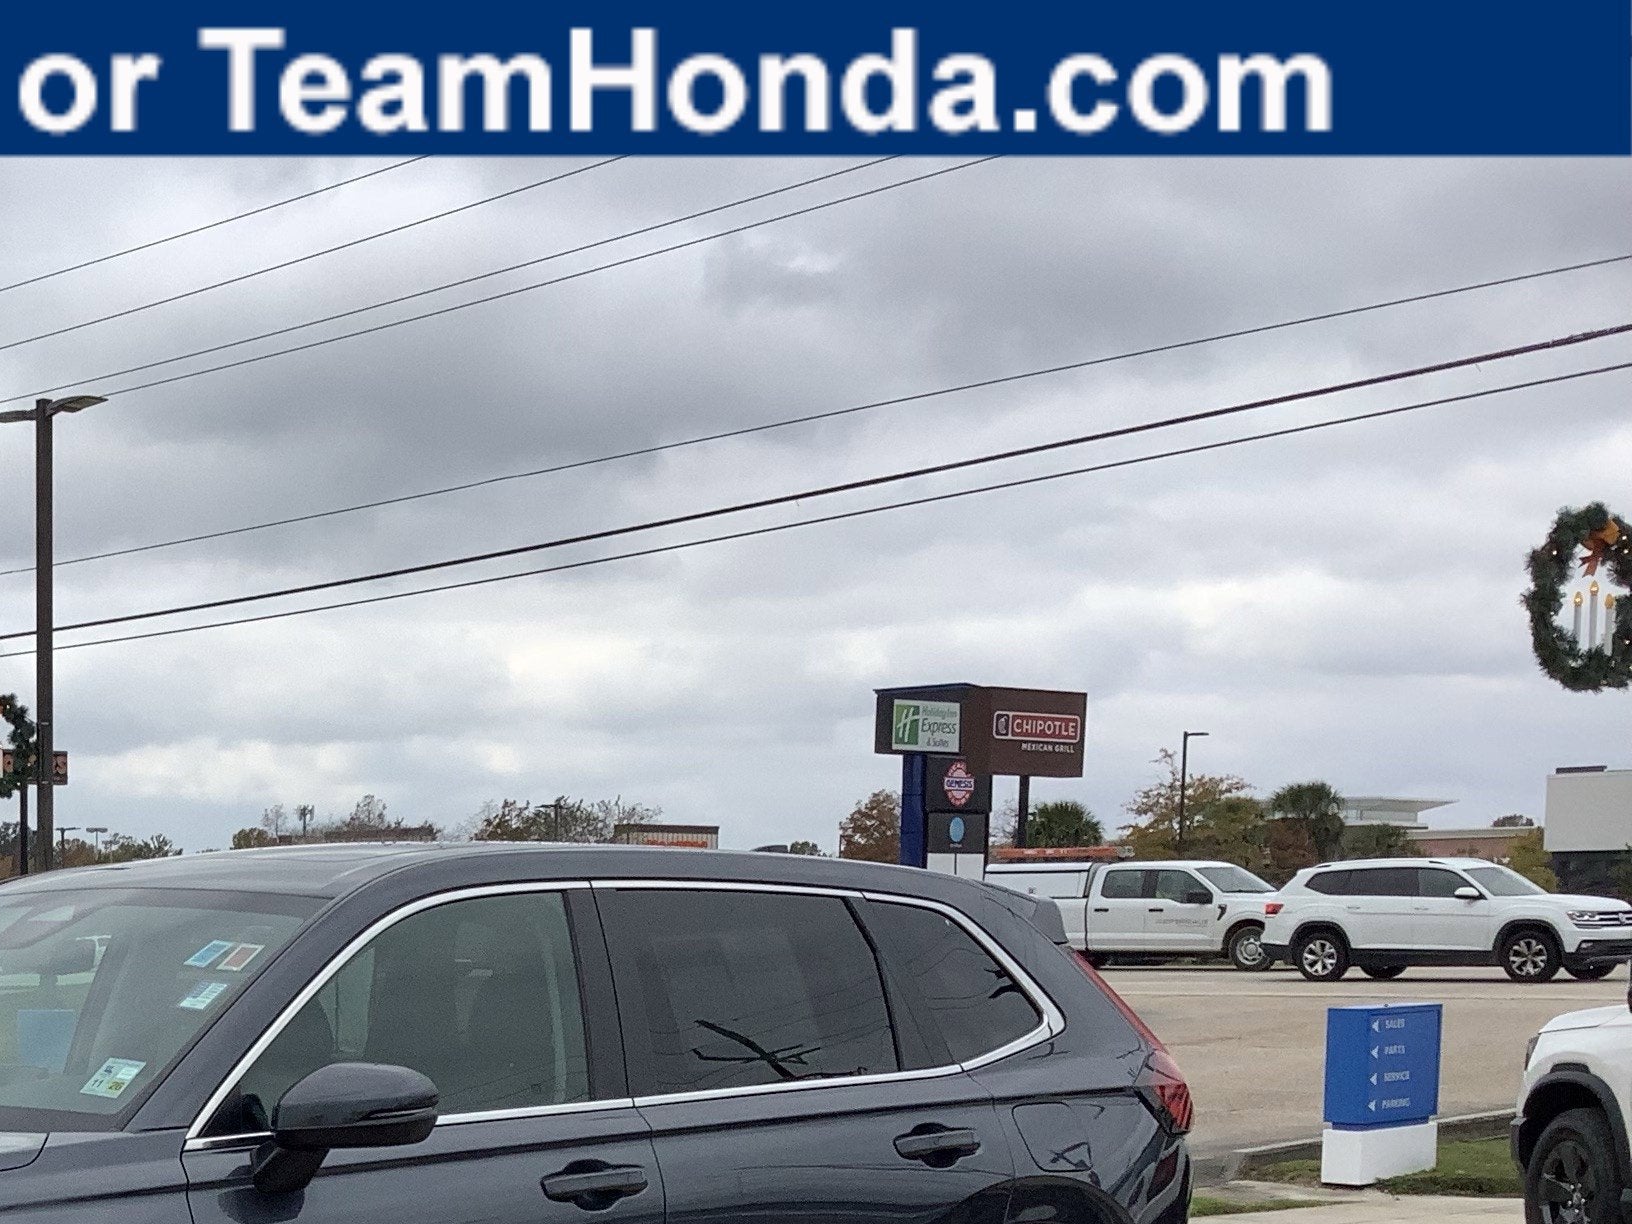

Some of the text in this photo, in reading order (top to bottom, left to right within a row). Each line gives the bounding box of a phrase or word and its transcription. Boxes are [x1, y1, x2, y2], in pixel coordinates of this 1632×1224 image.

[921, 717, 957, 736] Express
[1013, 718, 1076, 736] CHIPOTLE
[1021, 743, 1075, 753] MEXICAN GRILL
